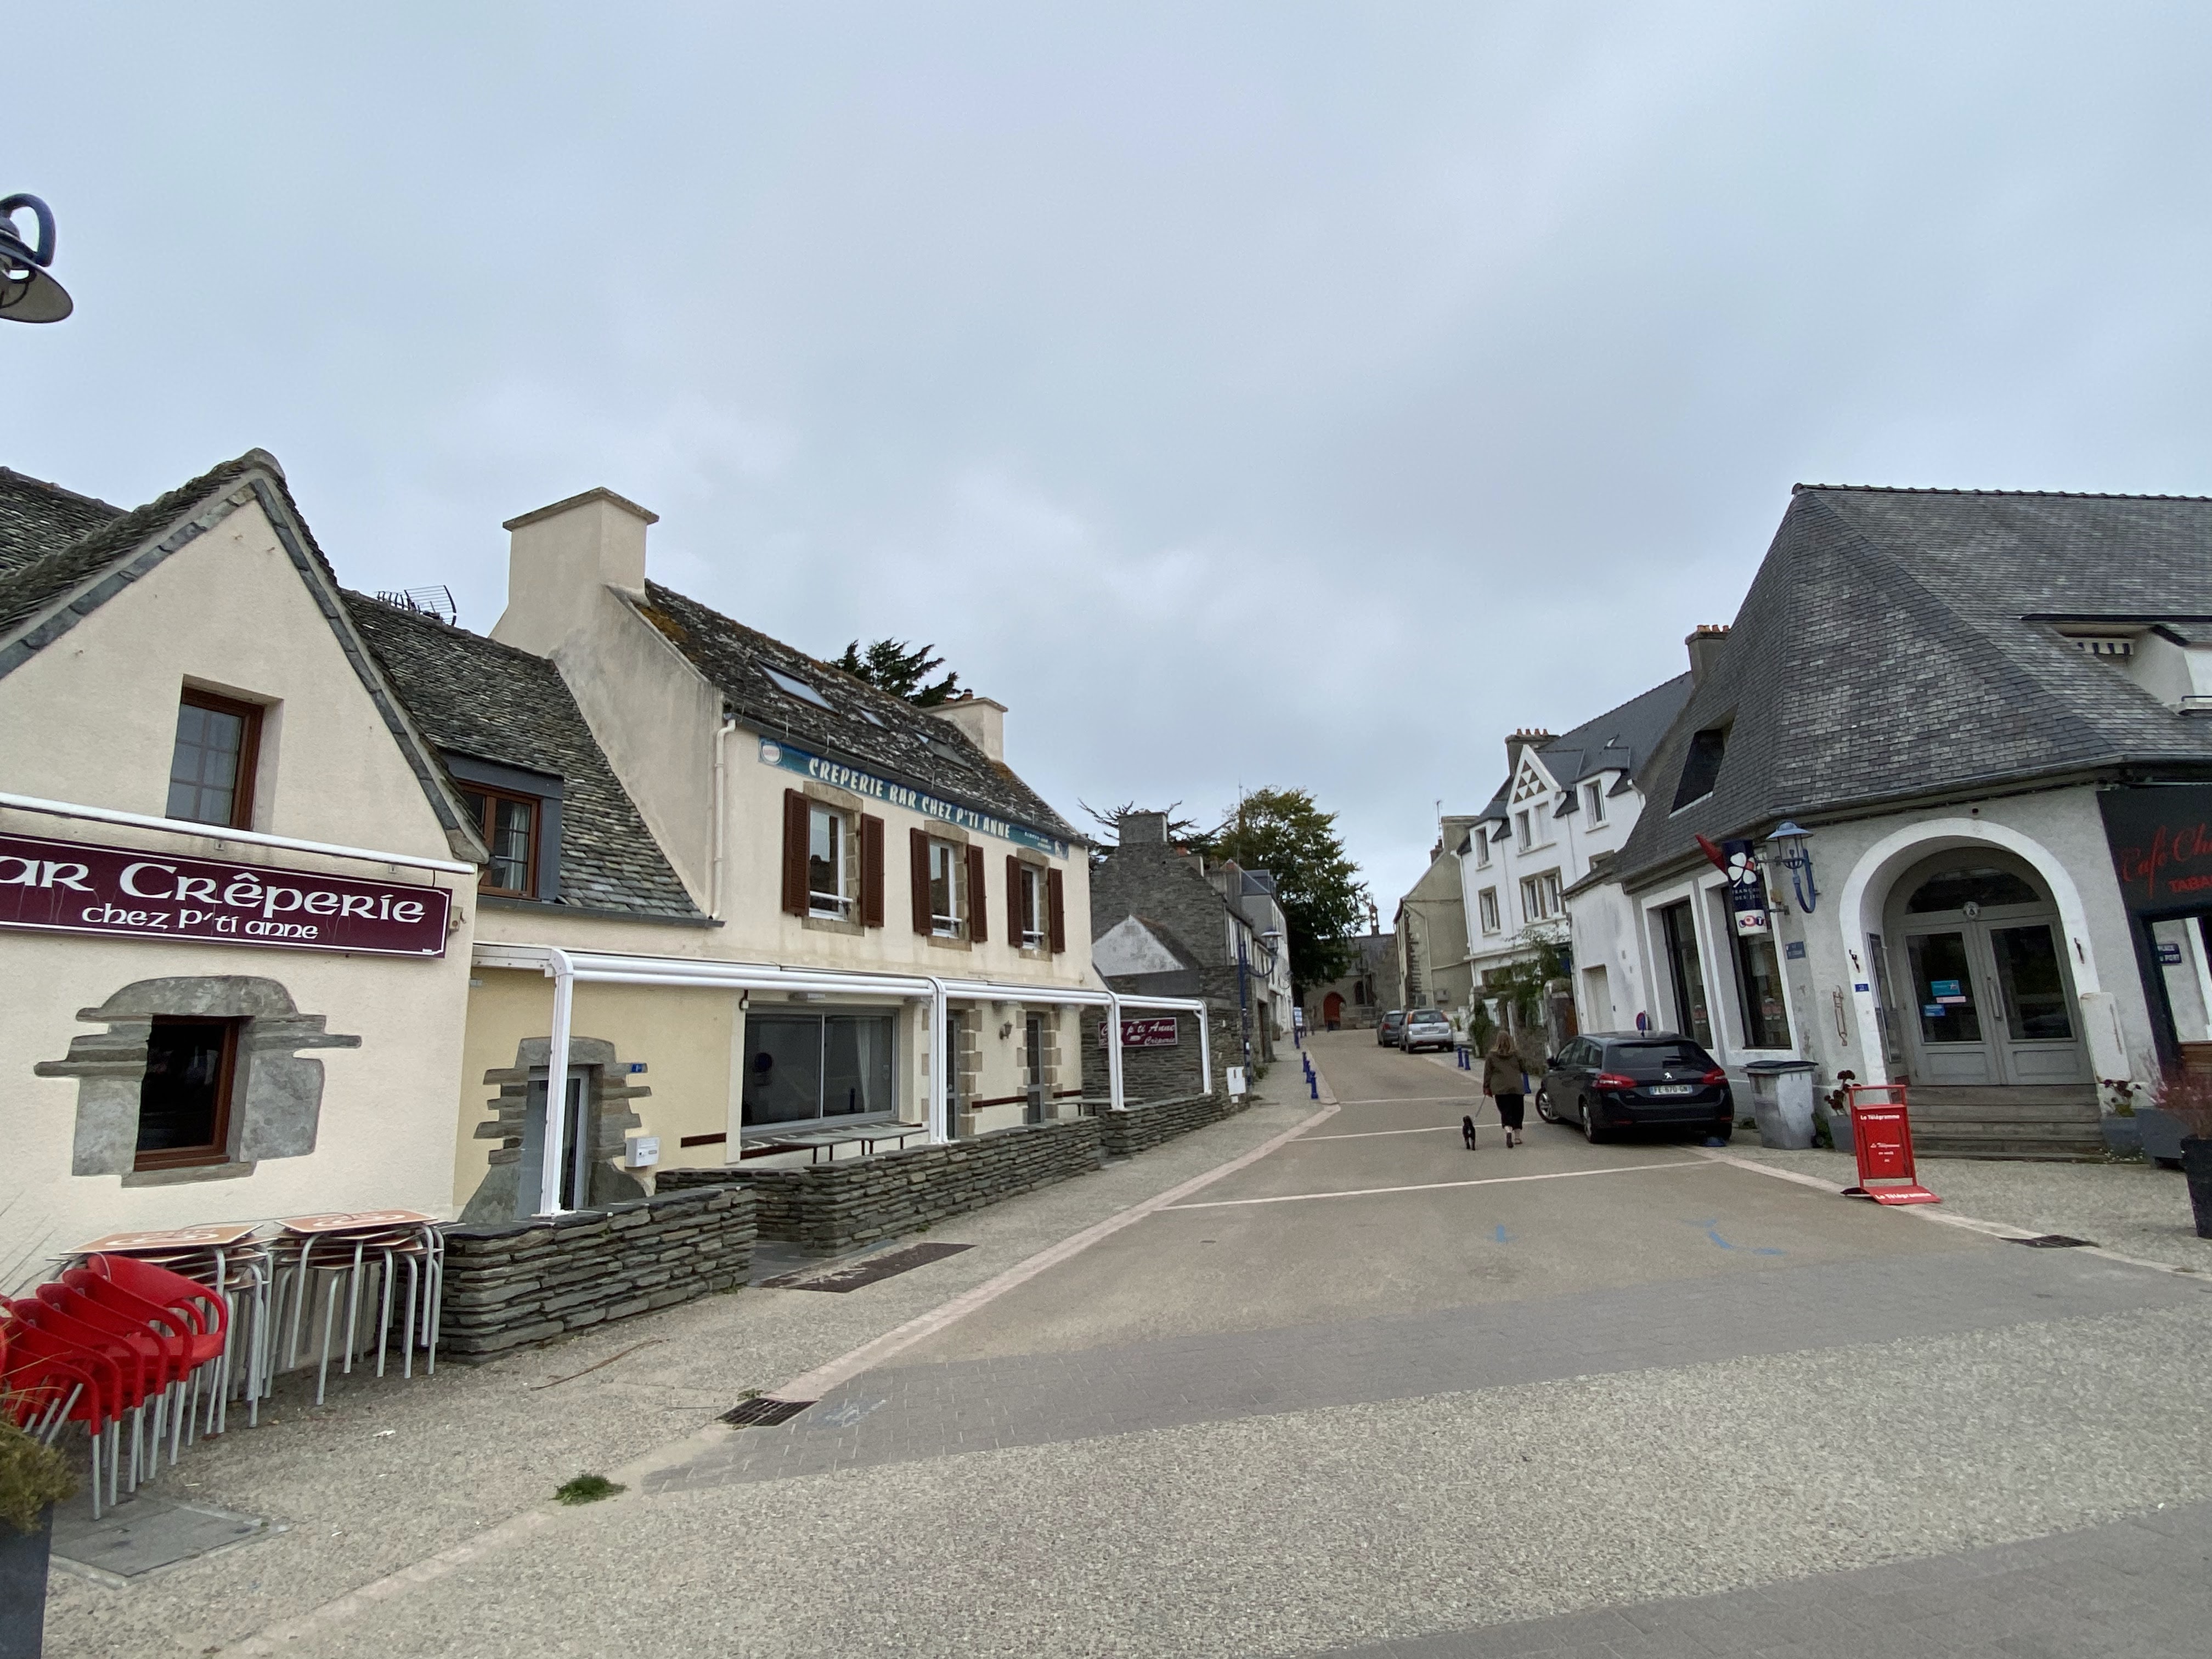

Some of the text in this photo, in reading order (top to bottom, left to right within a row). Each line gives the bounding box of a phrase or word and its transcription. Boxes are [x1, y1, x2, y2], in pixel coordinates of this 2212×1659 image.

[809, 757, 884, 797] CREPERIE
[889, 784, 917, 808] BAR
[922, 796, 952, 820] CHEZ
[956, 807, 979, 828] P'TI
[983, 816, 1010, 838] ANNE
[82, 902, 319, 940] chez p'ti anne
